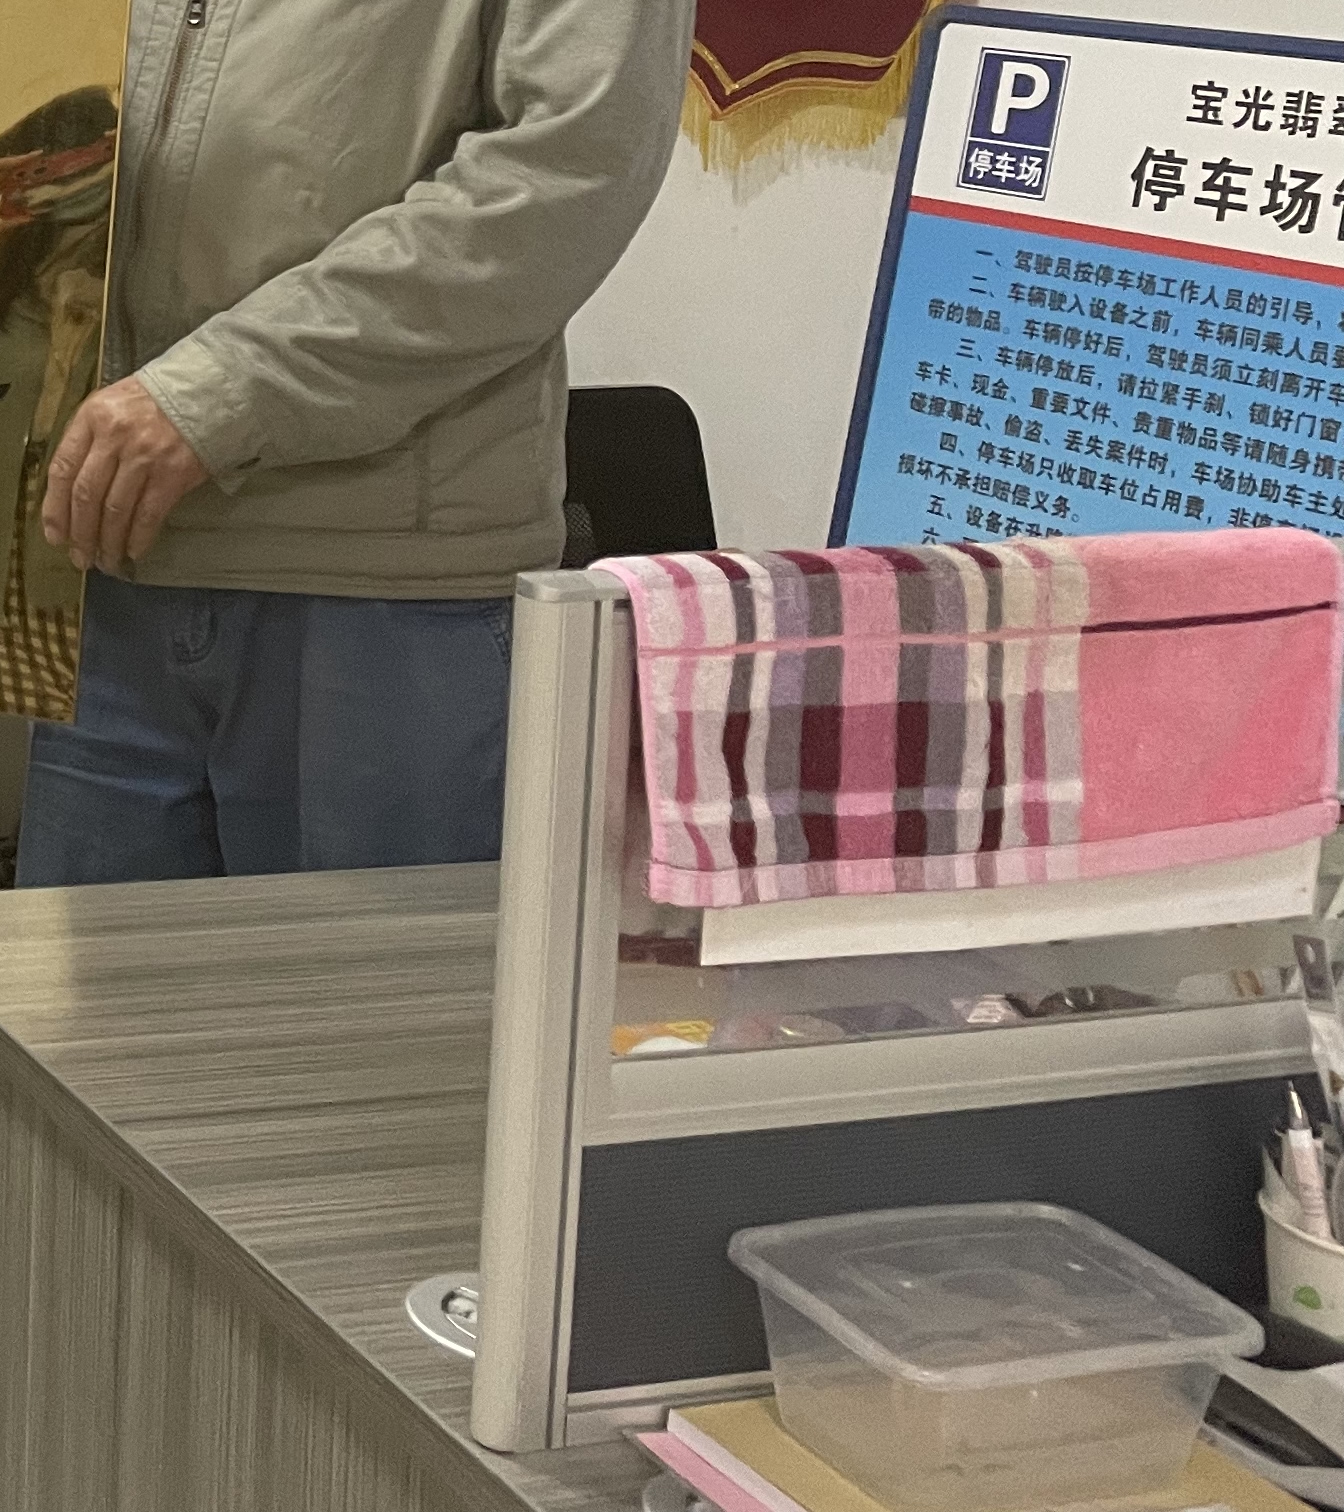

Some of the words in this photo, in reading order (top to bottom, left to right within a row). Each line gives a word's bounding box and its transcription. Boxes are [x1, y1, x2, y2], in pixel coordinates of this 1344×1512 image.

[990, 60, 1050, 134] P
[968, 147, 1044, 189] 停车场
[1130, 146, 1344, 241] 停车场
